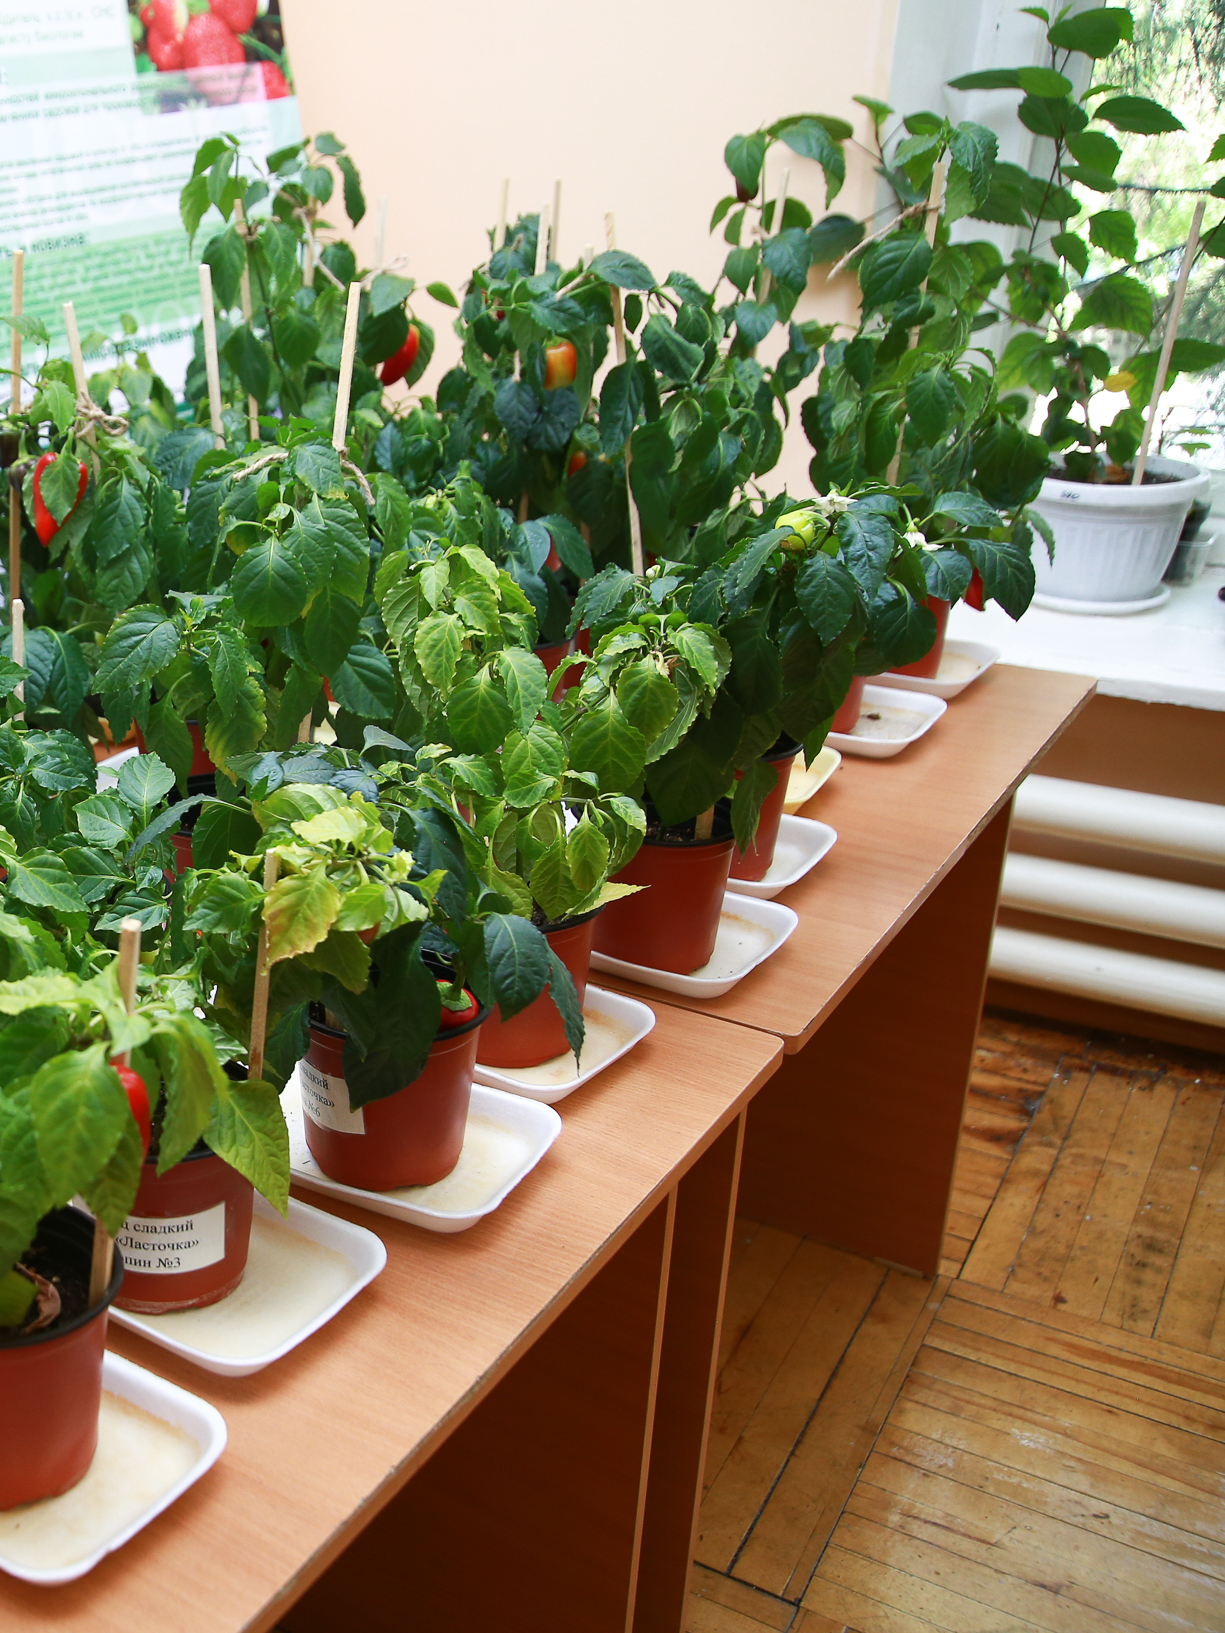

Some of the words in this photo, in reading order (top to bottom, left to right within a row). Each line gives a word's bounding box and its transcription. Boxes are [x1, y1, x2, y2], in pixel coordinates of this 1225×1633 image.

[133, 1219, 194, 1236] сладкий
[115, 1236, 200, 1252] «Ласточка»
[156, 1257, 181, 1269] №3
